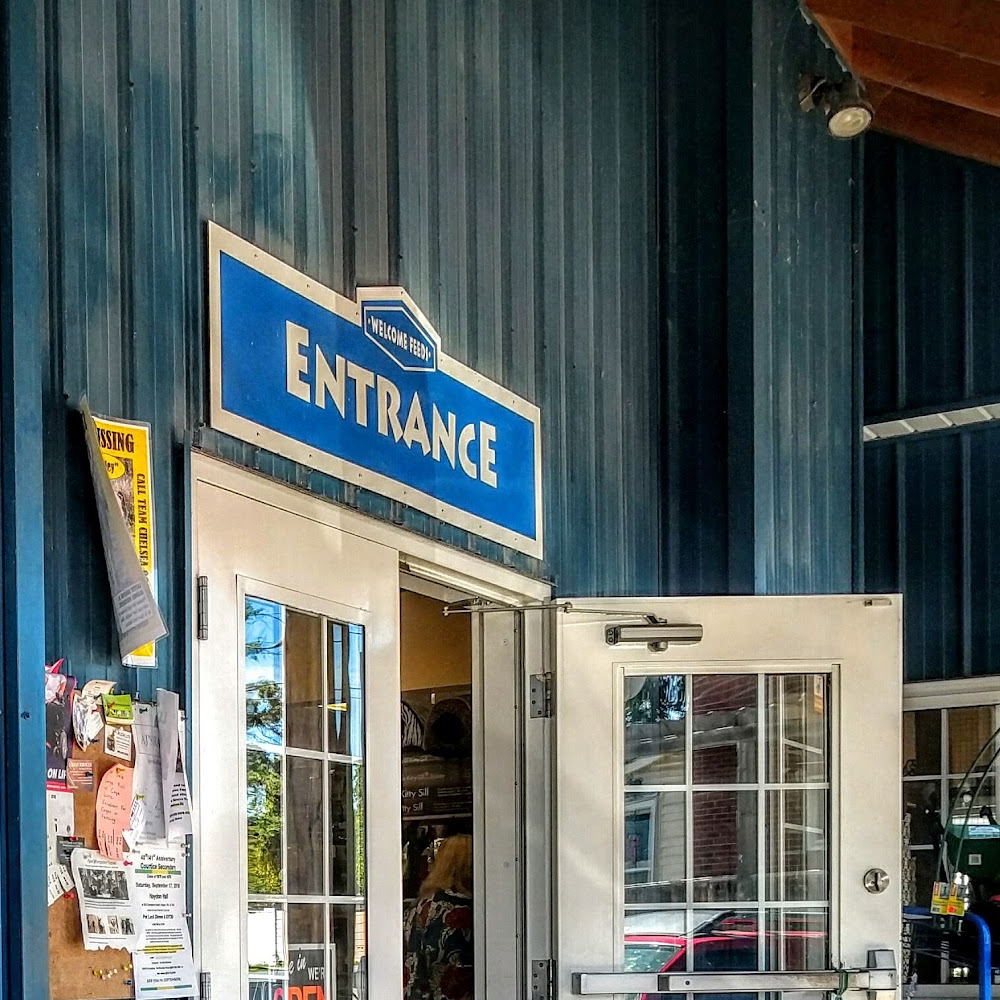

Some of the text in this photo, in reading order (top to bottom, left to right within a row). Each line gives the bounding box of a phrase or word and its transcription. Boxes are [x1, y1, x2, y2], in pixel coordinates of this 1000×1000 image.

[370, 315, 429, 362] WELCOME FEEDS
[286, 320, 497, 488] ENTRANCE
[96, 427, 134, 454] ISSING
[137, 473, 146, 495] CALL
[138, 499, 148, 524] TEAM
[138, 527, 149, 567] CHELSEA
[307, 966, 325, 981] WE'R
